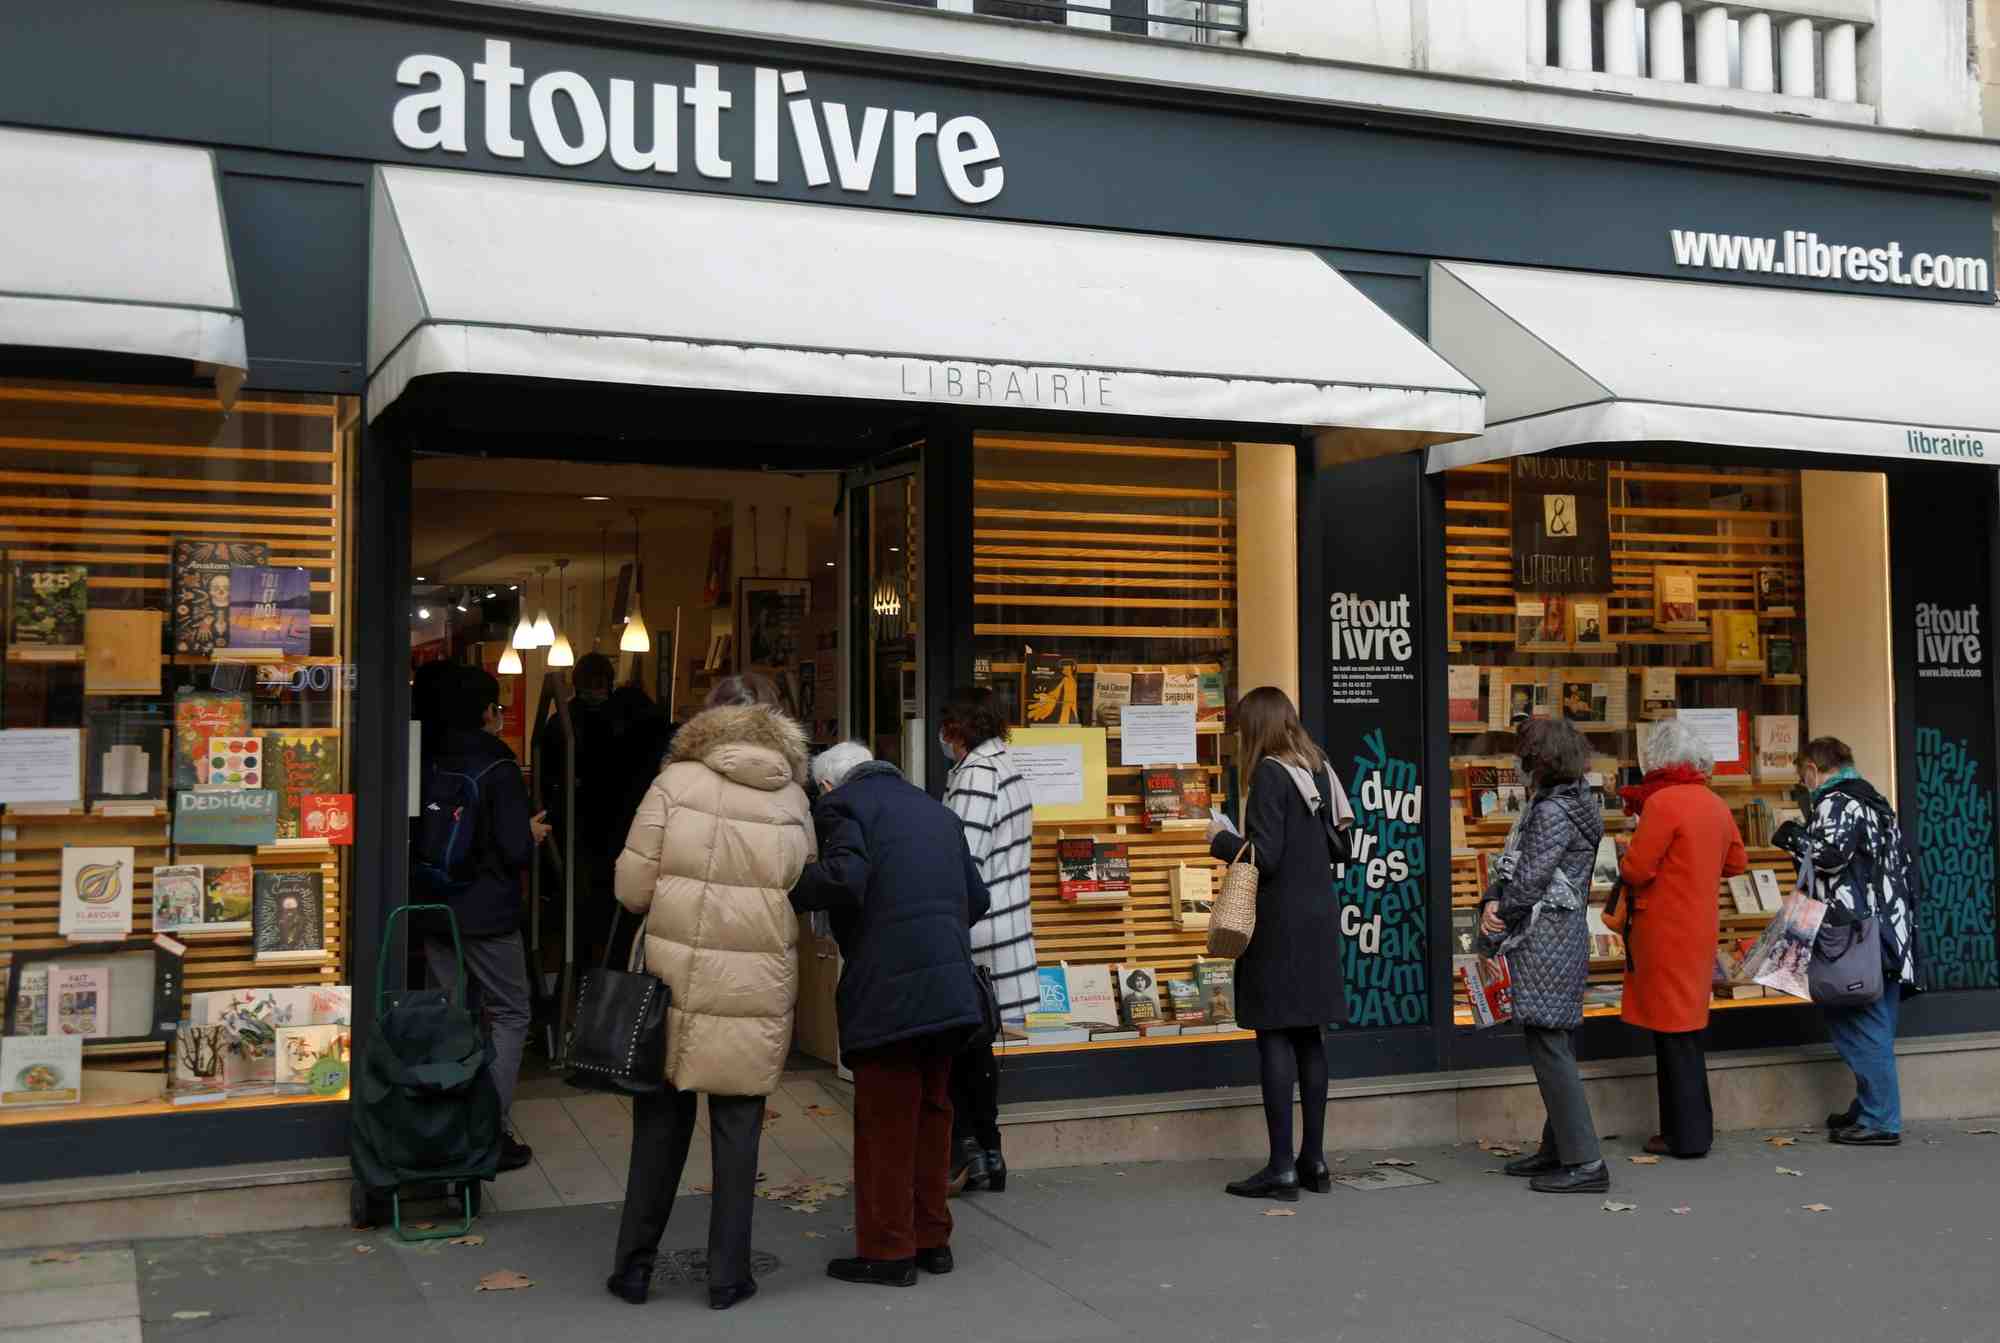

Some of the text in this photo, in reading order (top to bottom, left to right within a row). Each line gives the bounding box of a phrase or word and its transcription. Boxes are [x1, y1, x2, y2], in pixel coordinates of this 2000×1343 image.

[392, 38, 1005, 205] atout livre
[1669, 229, 1990, 292] www.librest.com
[901, 363, 1113, 407] LIBRAIRIE
[1906, 430, 1985, 458] librairie
[1329, 592, 1411, 629] atout
[1914, 602, 1981, 635] atout
[1331, 620, 1413, 662] livre
[1916, 627, 1982, 665] livre
[1361, 770, 1423, 824] dvd
